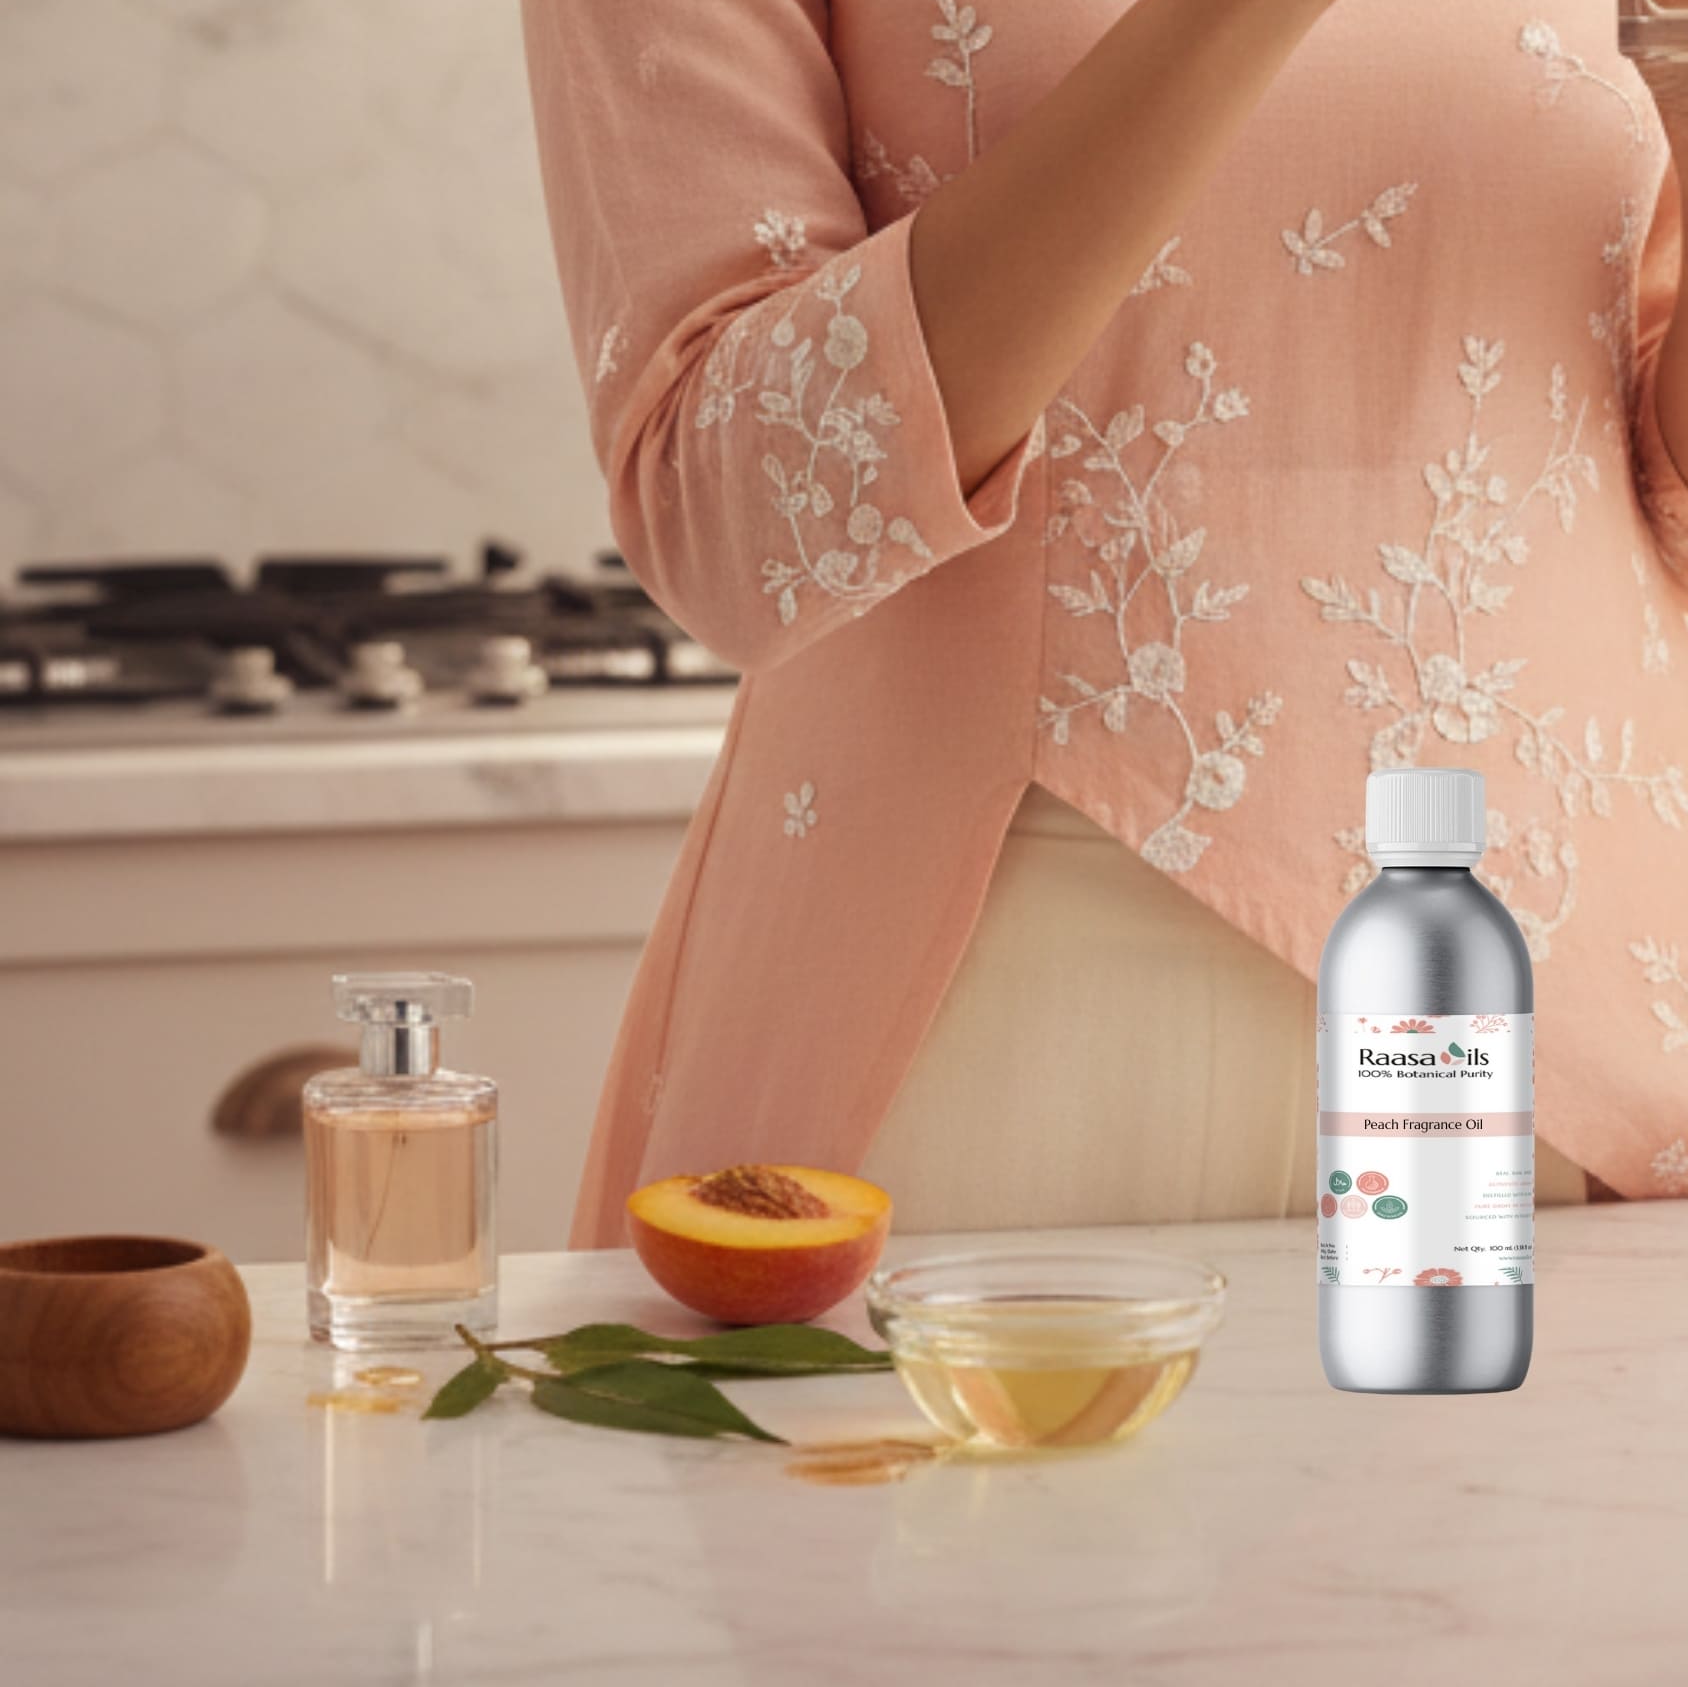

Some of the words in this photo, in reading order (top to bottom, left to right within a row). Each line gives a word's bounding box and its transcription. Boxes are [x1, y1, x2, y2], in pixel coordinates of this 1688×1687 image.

[1359, 1048, 1436, 1066] Raasa
[1358, 1070, 1393, 1078] 100%
[1397, 1070, 1457, 1079] Botanical
[1460, 1070, 1494, 1080] Purity
[1364, 1118, 1399, 1130] Peach
[1403, 1118, 1462, 1133] Fragrance
[1465, 1118, 1483, 1130] Oil
